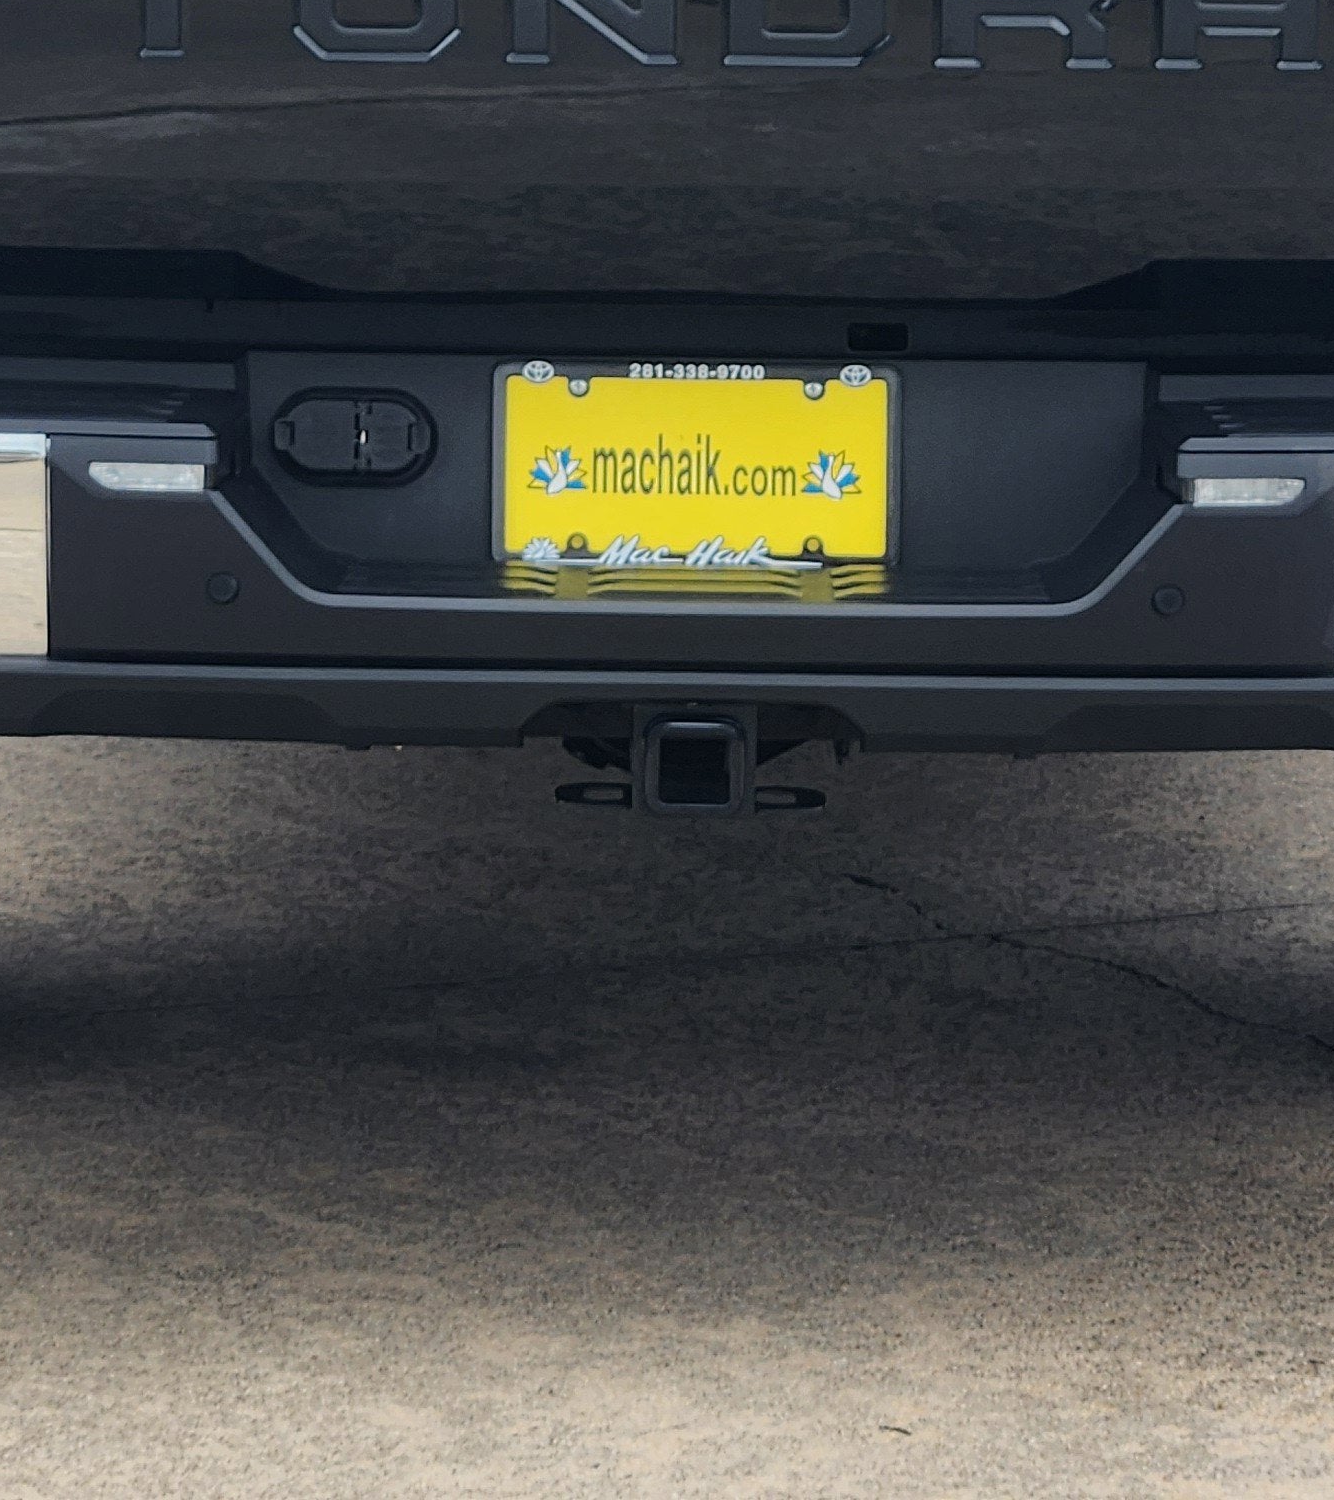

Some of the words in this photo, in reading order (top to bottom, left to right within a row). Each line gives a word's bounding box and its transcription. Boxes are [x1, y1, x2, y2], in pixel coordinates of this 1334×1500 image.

[591, 432, 797, 497] machaik.com
[598, 533, 684, 567] Mac
[683, 534, 823, 570] Haik
